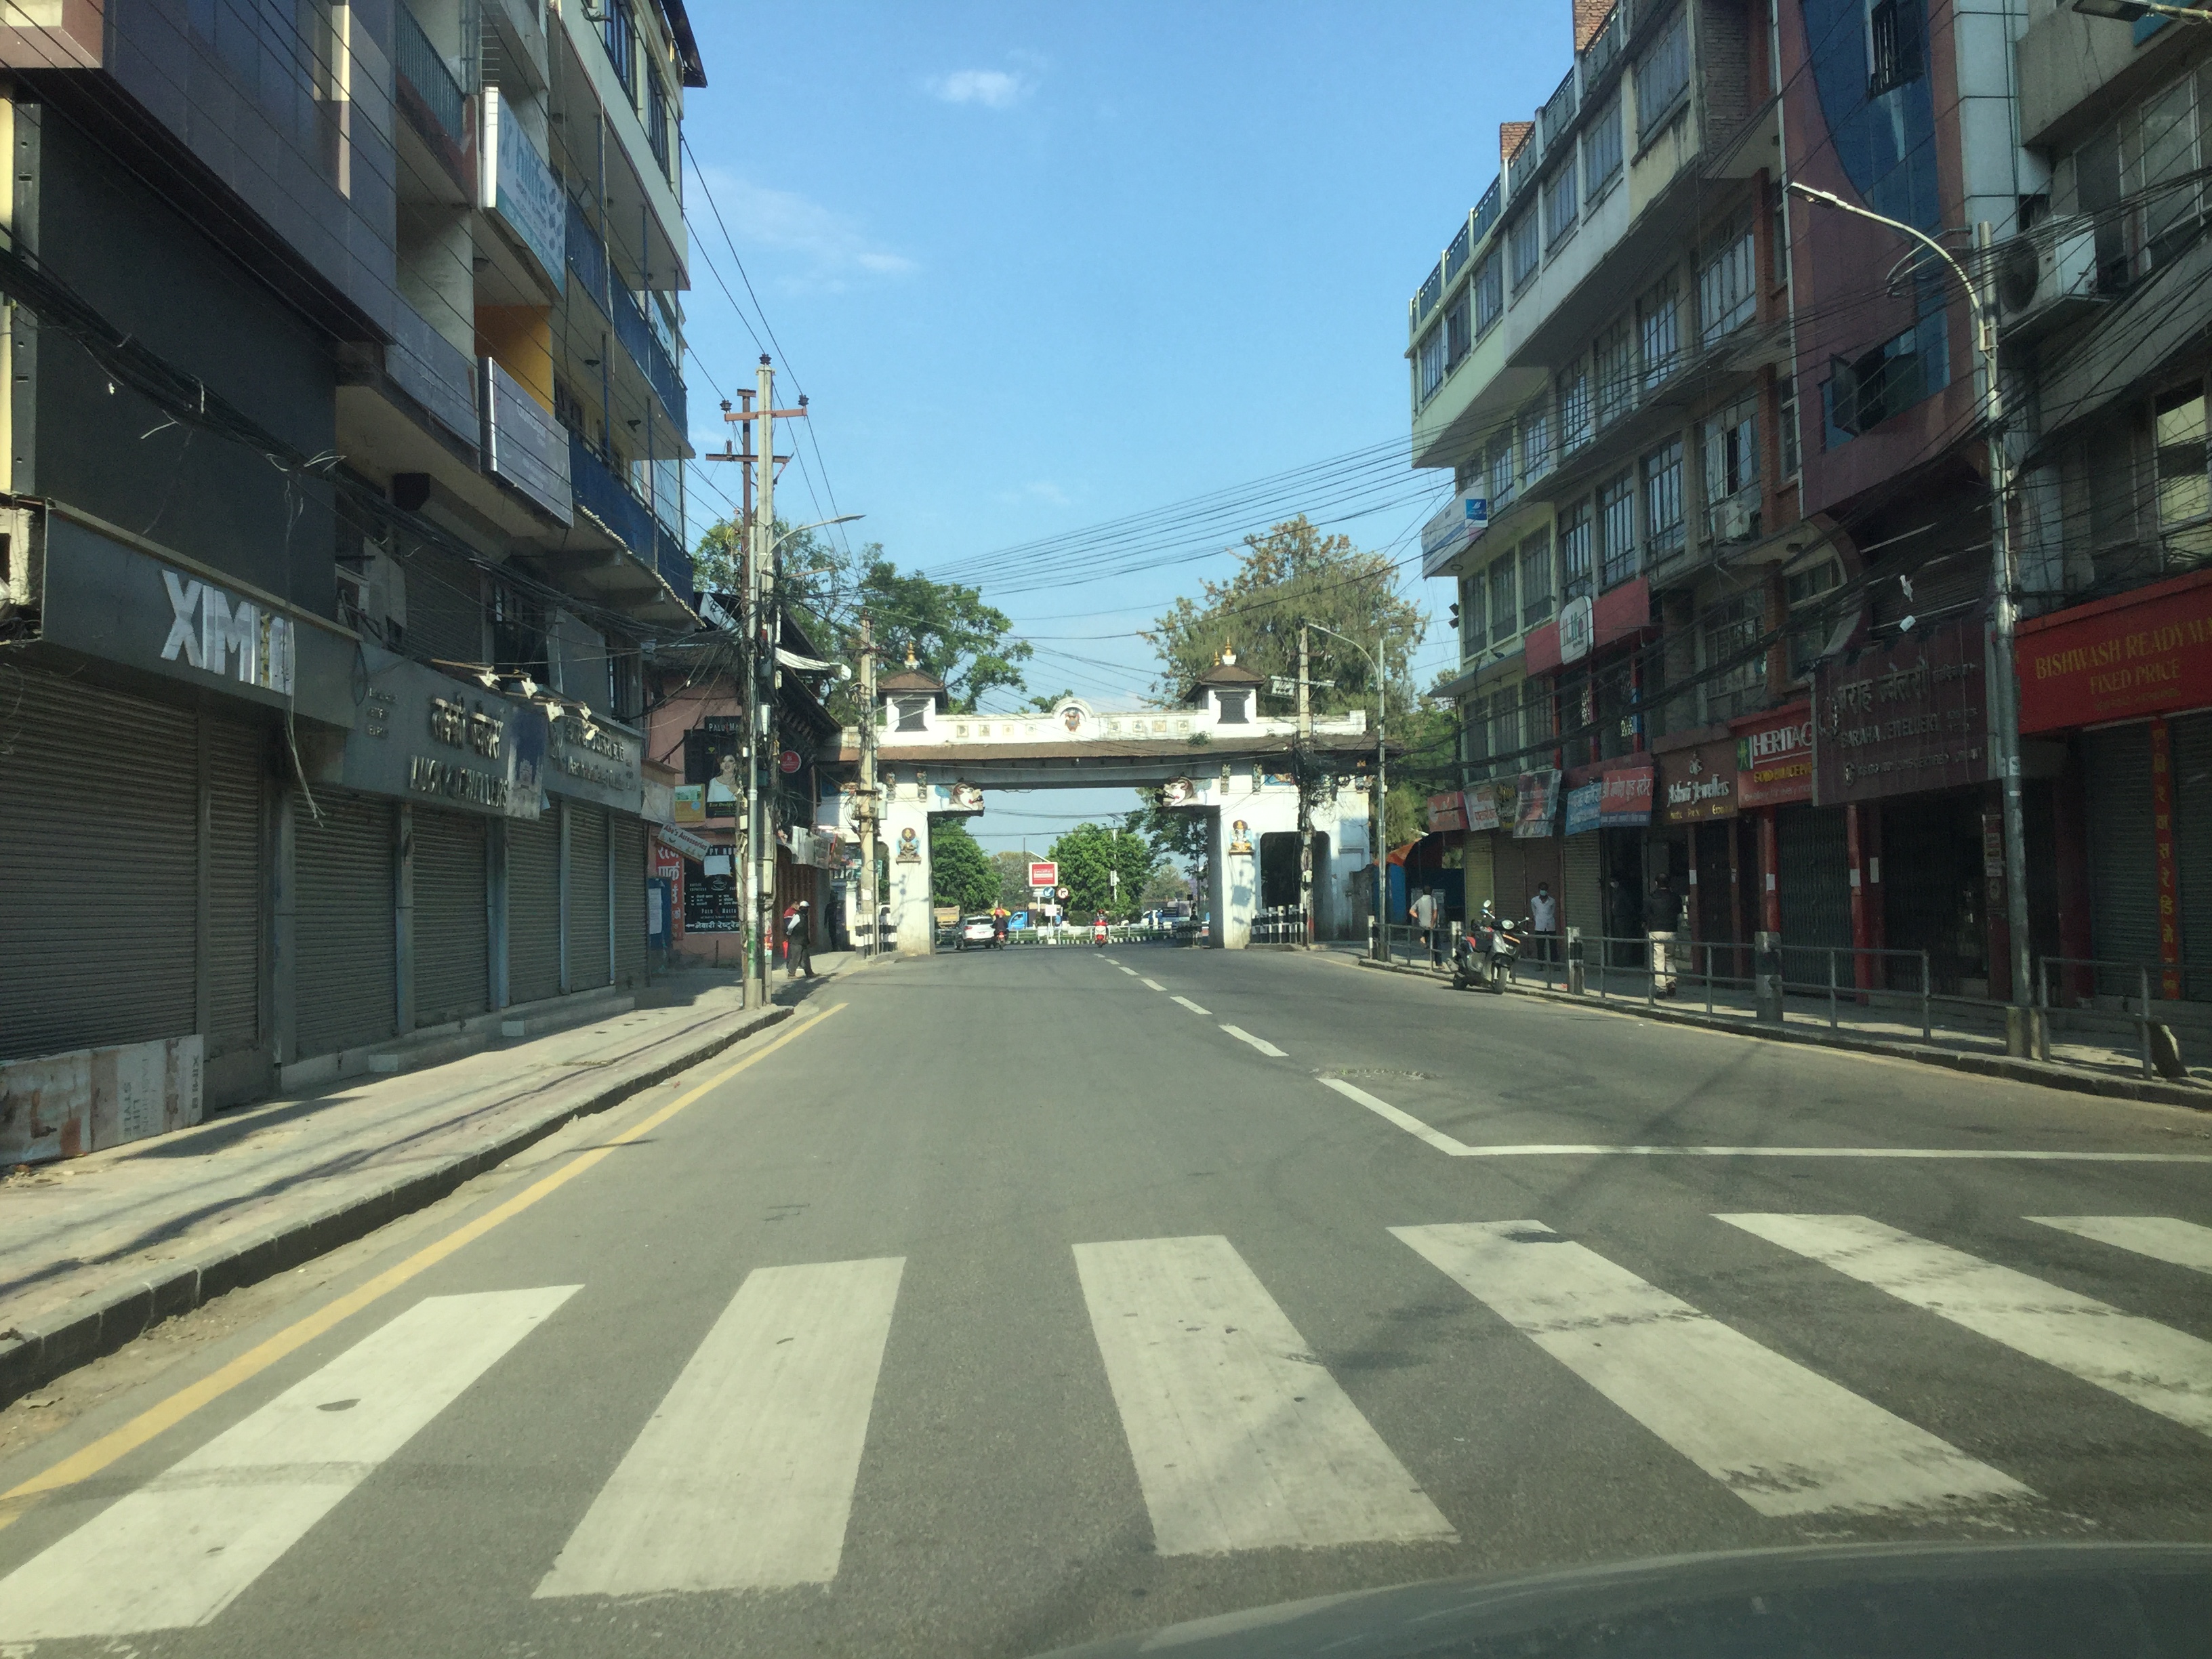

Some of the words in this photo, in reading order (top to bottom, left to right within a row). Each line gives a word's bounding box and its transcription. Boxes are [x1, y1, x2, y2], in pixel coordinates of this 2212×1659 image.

[2035, 638, 2122, 680] BISHWASH
[2125, 623, 2184, 659] READY
[2090, 669, 2132, 695] FIXED
[2135, 657, 2182, 687] PRICE
[1753, 721, 1813, 757] HERITAG
